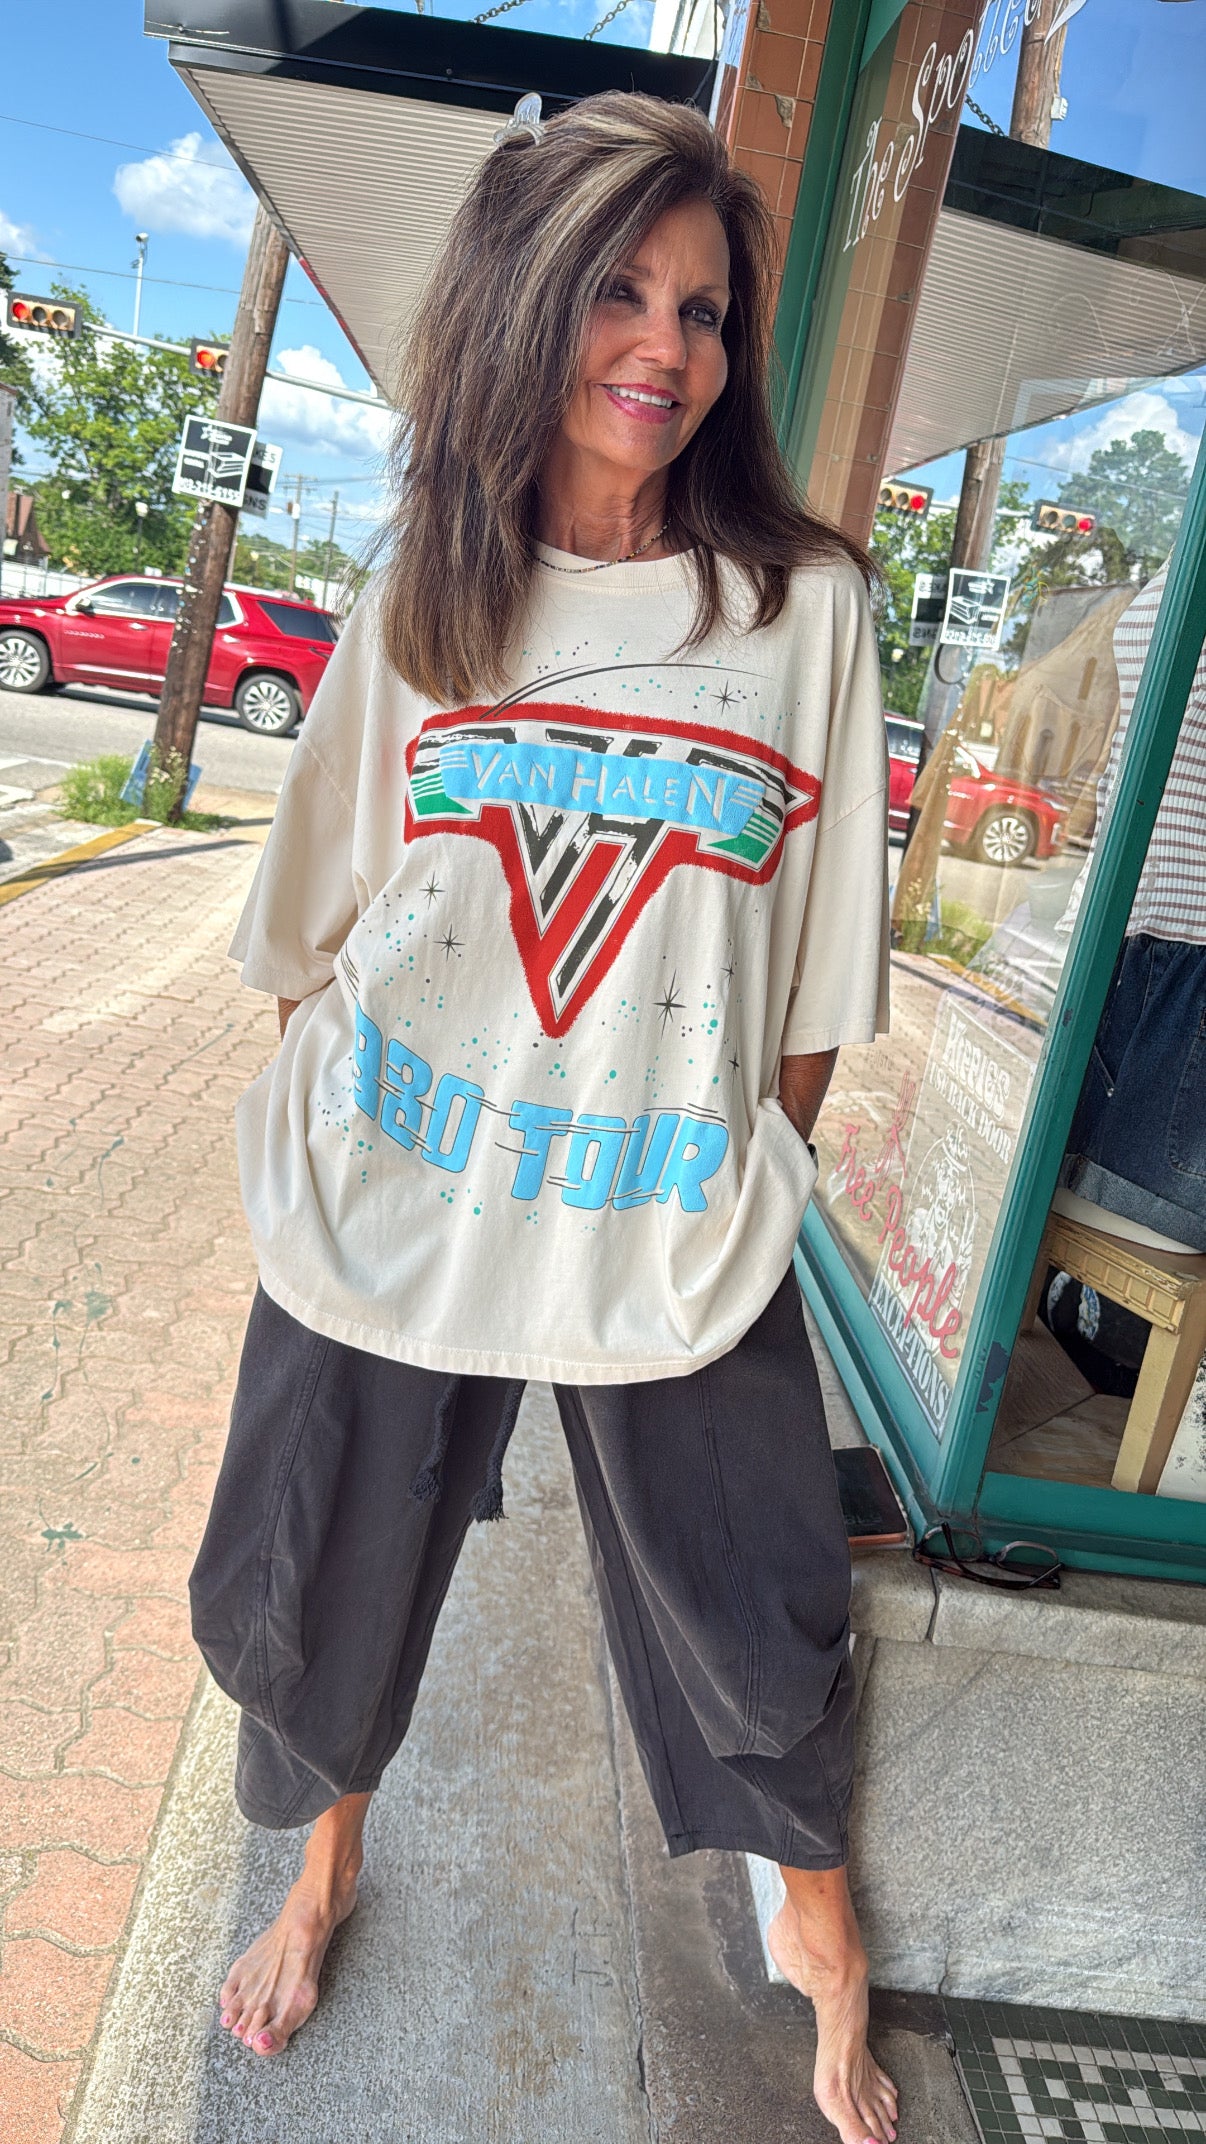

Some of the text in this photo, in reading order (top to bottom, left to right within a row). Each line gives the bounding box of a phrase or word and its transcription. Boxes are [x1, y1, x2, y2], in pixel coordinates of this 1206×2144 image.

[843, 0, 1040, 252] The Spotte
[471, 751, 726, 824] VAN HALEN
[929, 1061, 1013, 1165] USE BACK DOOR
[941, 1012, 1011, 1121] HIPPIES
[508, 1100, 730, 1213] TOUR
[835, 1123, 963, 1359] Free People
